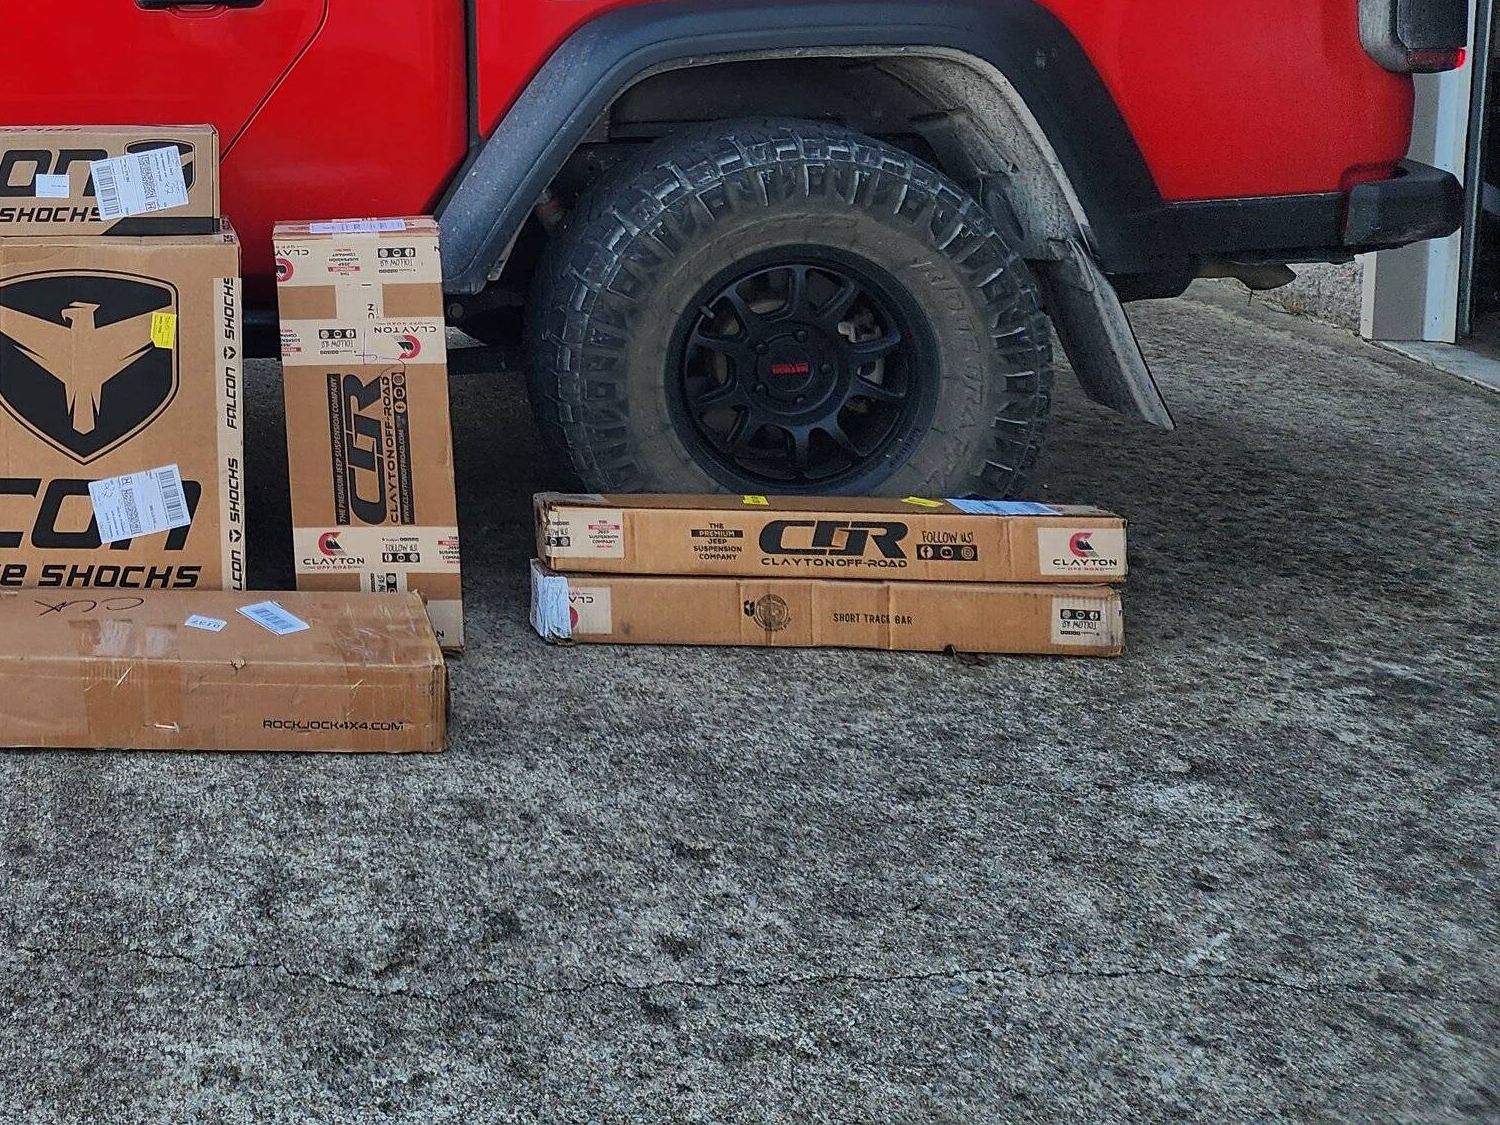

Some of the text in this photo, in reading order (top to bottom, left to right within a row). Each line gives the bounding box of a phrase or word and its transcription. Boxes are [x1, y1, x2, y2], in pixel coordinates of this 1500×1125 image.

[223, 278, 237, 429] FALCON SHOCKS
[329, 377, 340, 412] COMPANY
[332, 413, 342, 456] SUSPENSION
[334, 457, 343, 474] JEEP
[336, 475, 345, 510] PREMIUM
[228, 457, 242, 591] LCON SHOCKS
[922, 531, 957, 543] FOLLOW
[1053, 558, 1117, 566] CLAYTON
[38, 563, 202, 588] SHOCKS
[833, 613, 913, 625] SHORT TRACK BAR
[262, 719, 404, 731] ROCKJOCK4X4.COM
